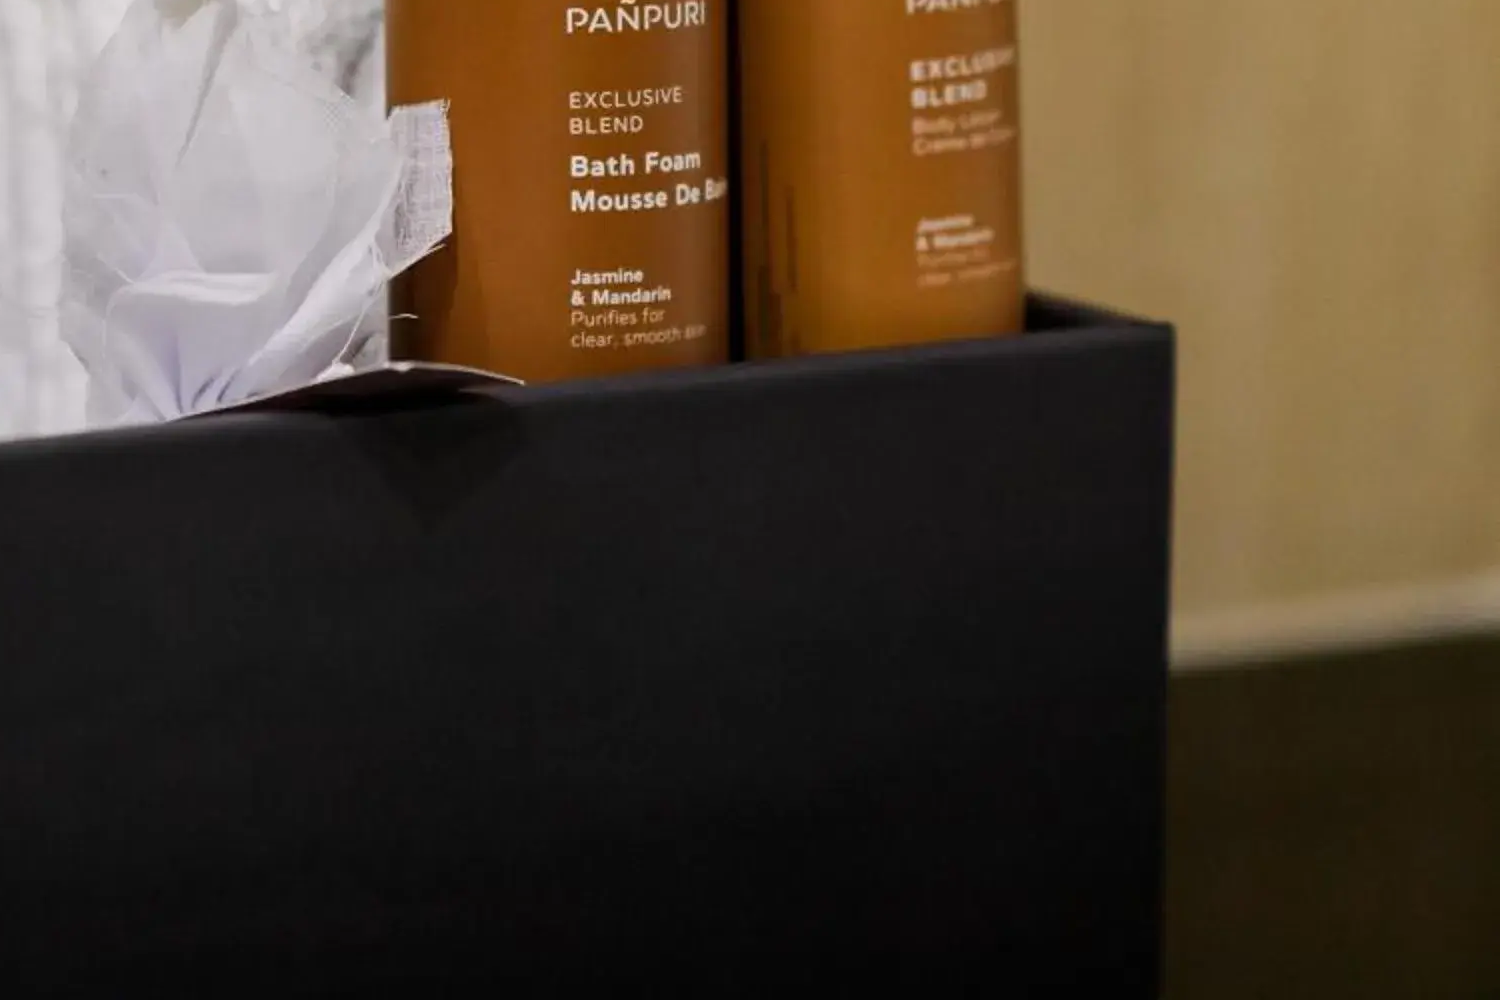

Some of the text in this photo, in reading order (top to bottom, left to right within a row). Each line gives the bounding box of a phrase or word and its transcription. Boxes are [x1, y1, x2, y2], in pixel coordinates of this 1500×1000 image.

[568, 86, 684, 110] EXCLUSIVE
[568, 115, 644, 136] BLEND
[570, 151, 702, 178] Bath Foam
[570, 188, 669, 212] Mousse
[674, 183, 701, 206] De
[570, 267, 644, 286] Jasmine
[570, 285, 672, 307] & Mandarin
[570, 306, 666, 329] Purifies for
